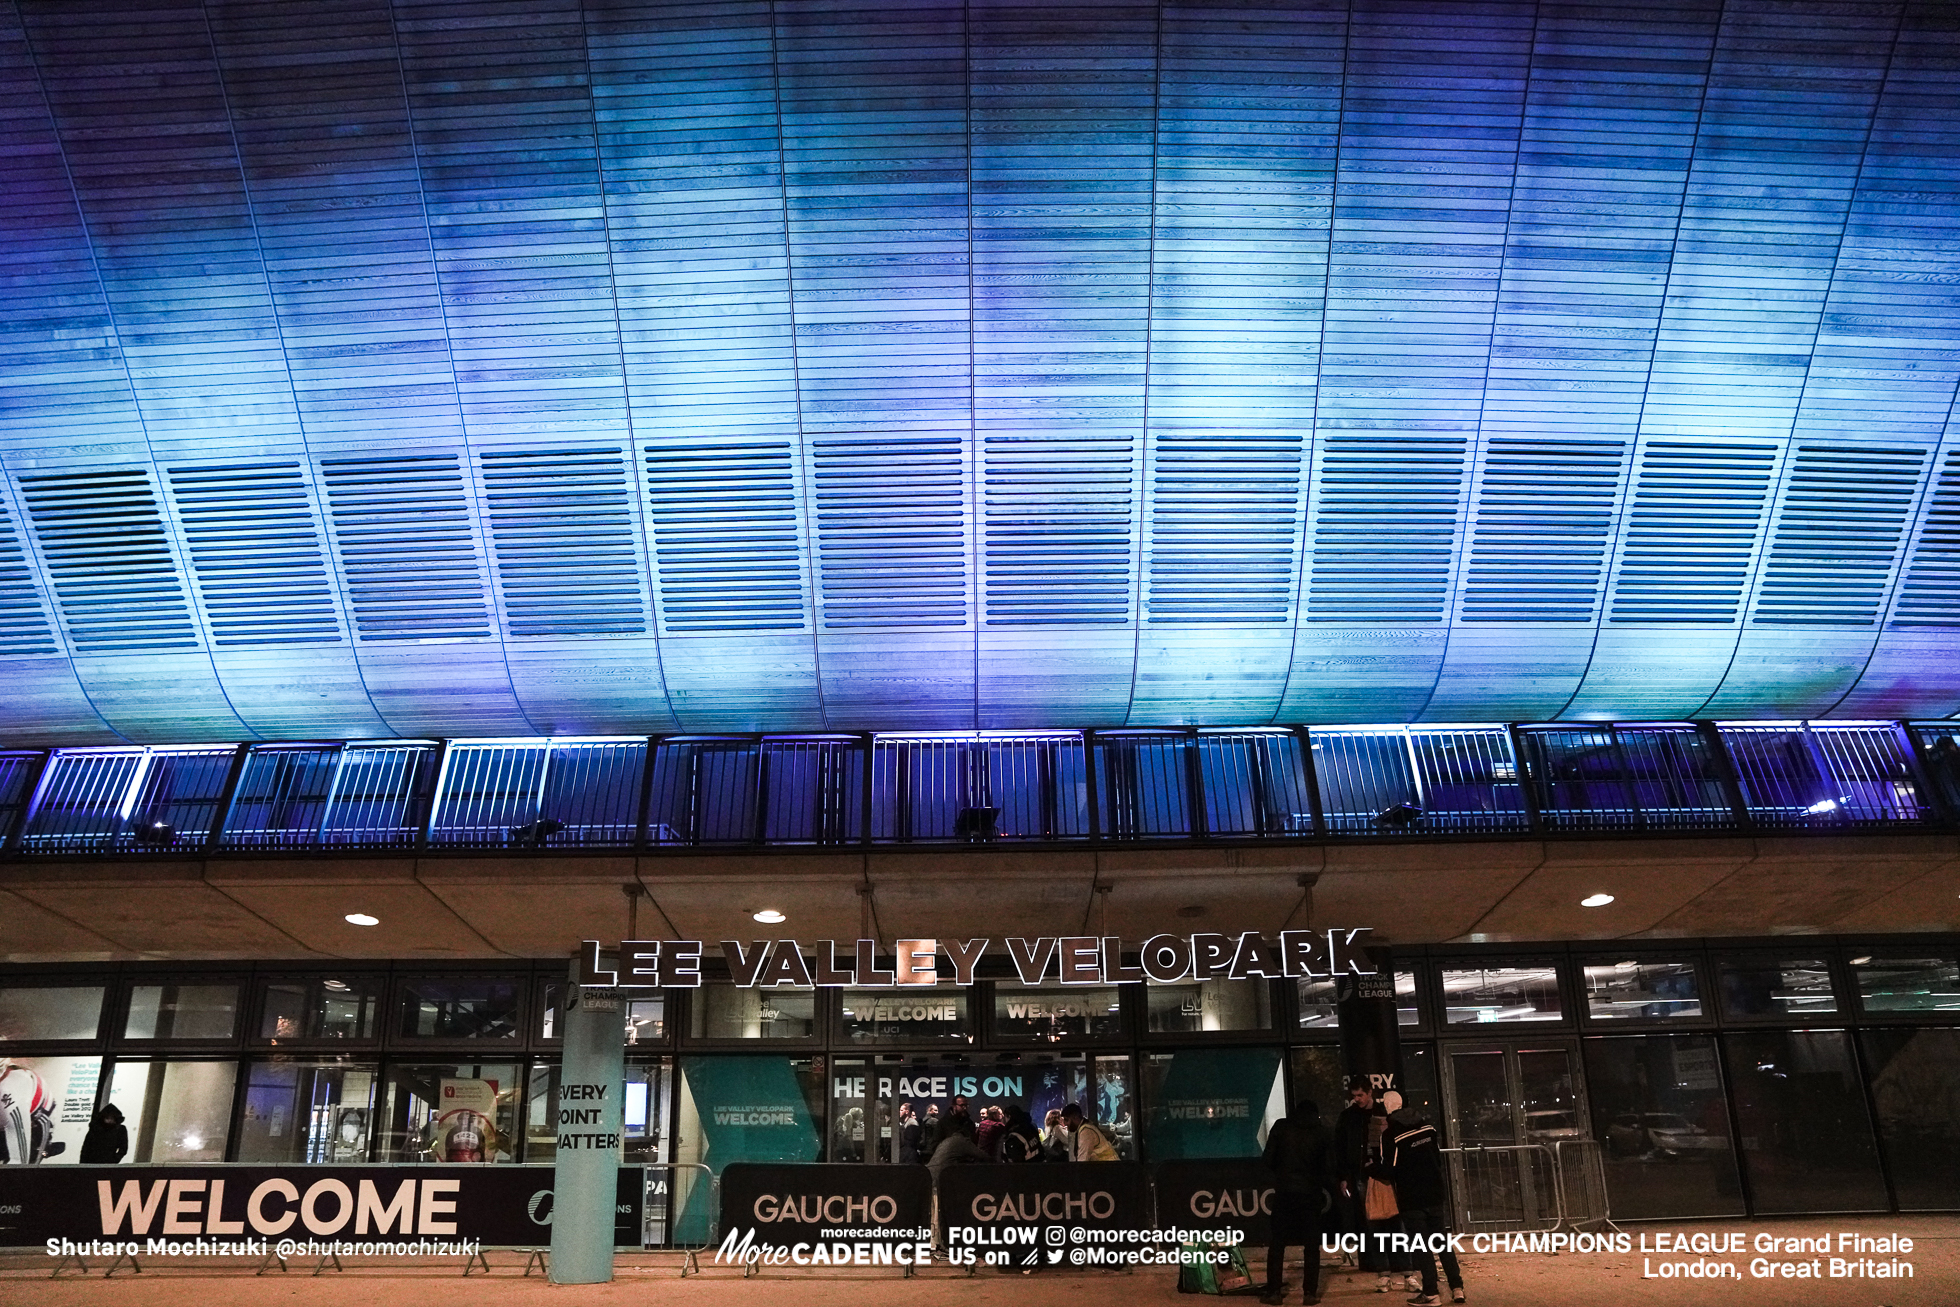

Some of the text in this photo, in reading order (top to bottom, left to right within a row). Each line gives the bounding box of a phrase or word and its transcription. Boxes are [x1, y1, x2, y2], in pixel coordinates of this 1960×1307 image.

[579, 927, 1378, 988] LEE VALLEY VELOPARK
[1358, 990, 1393, 998] LEAGUE
[583, 1000, 619, 1009] LEAGUE
[1006, 1002, 1110, 1019] WELCOME
[854, 1006, 957, 1022] WELCOME
[883, 1026, 900, 1034] UCI
[560, 1084, 609, 1100] VERY.
[834, 1076, 1023, 1098] HE RACE IS ON
[558, 1109, 603, 1125] OINT.
[713, 1113, 794, 1126] WELCOME
[1168, 1105, 1249, 1119] WELCOME
[559, 1134, 620, 1149] ATTERS
[97, 1178, 461, 1236] WELCOME
[753, 1194, 897, 1224] GAUCHO
[971, 1191, 1115, 1222] GAUCHO
